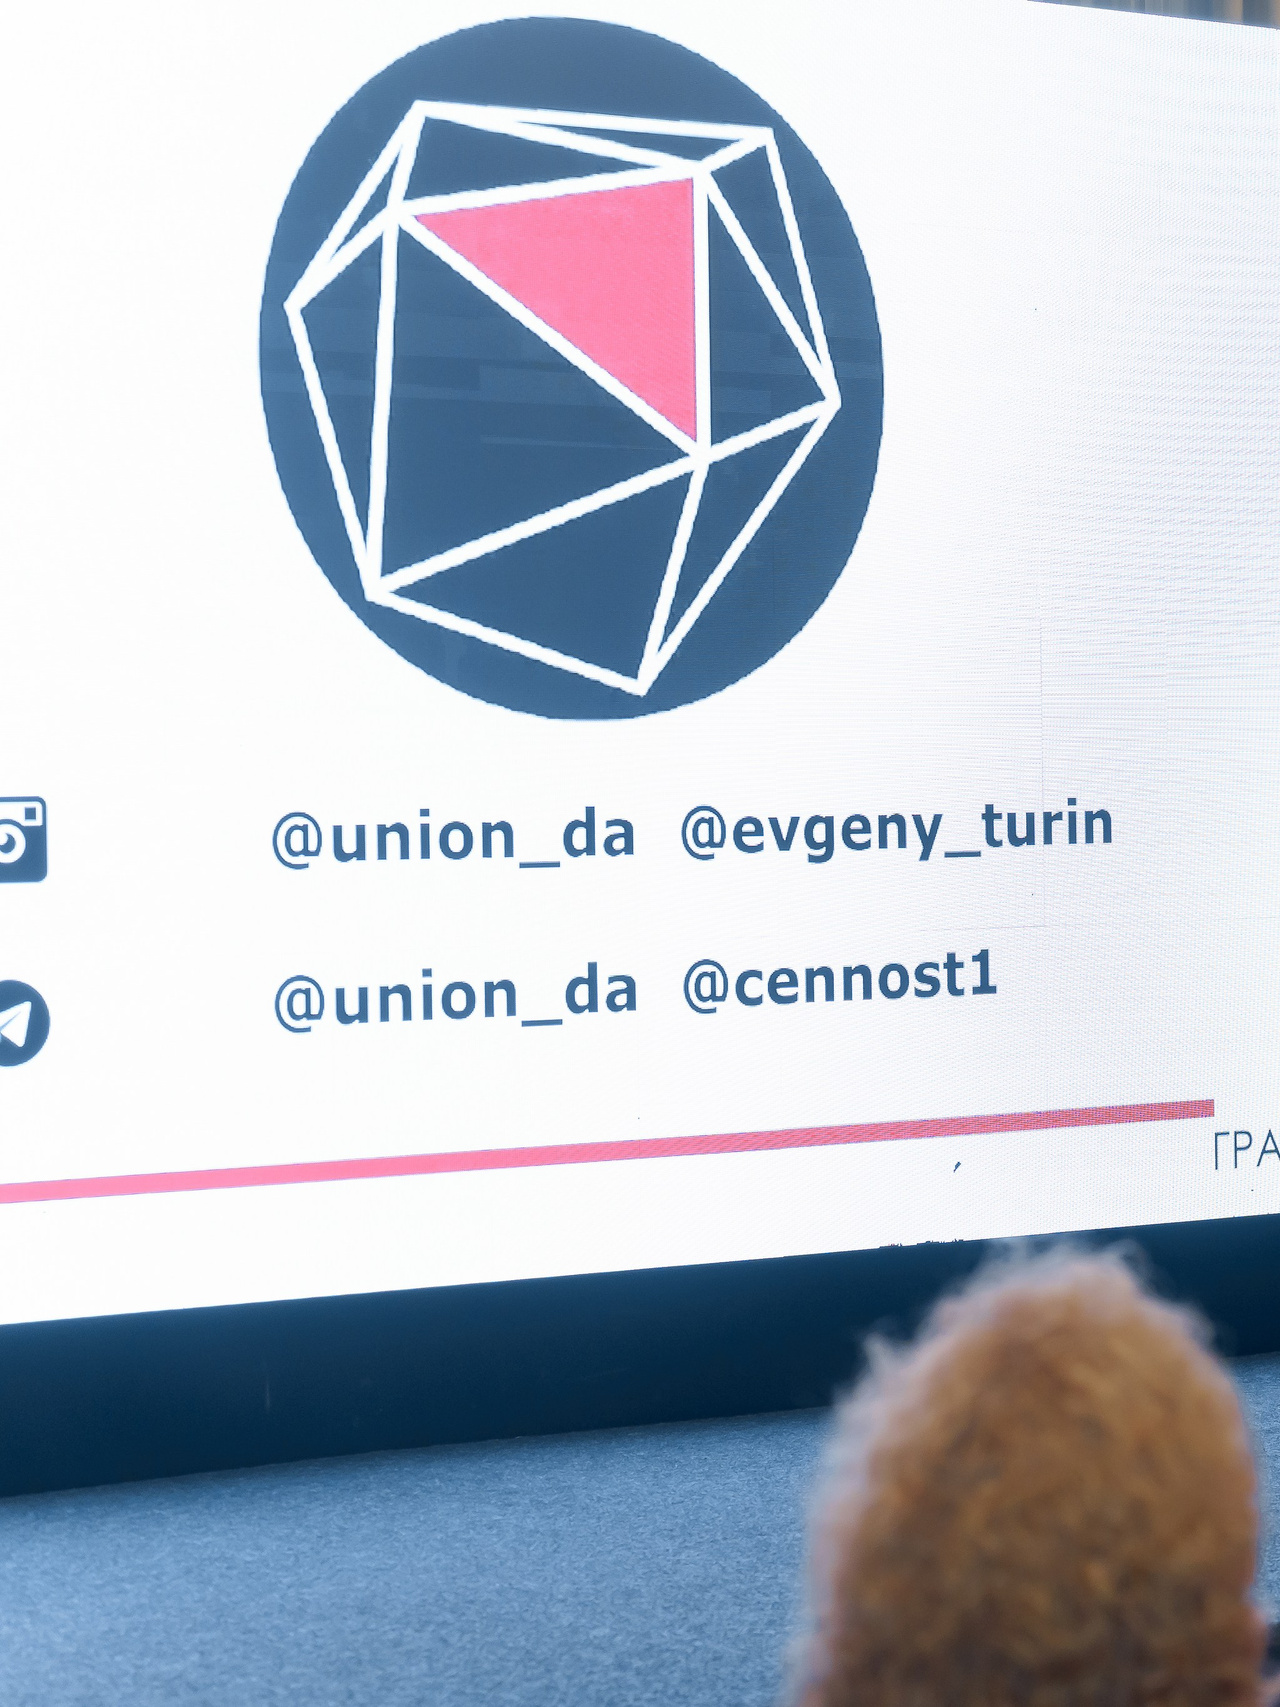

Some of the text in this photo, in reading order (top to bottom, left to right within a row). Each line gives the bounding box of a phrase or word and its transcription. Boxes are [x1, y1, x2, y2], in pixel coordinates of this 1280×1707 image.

[272, 797, 1113, 870] @union_da @evgeny_turin
[274, 948, 998, 1034] @union_da @cennost1
